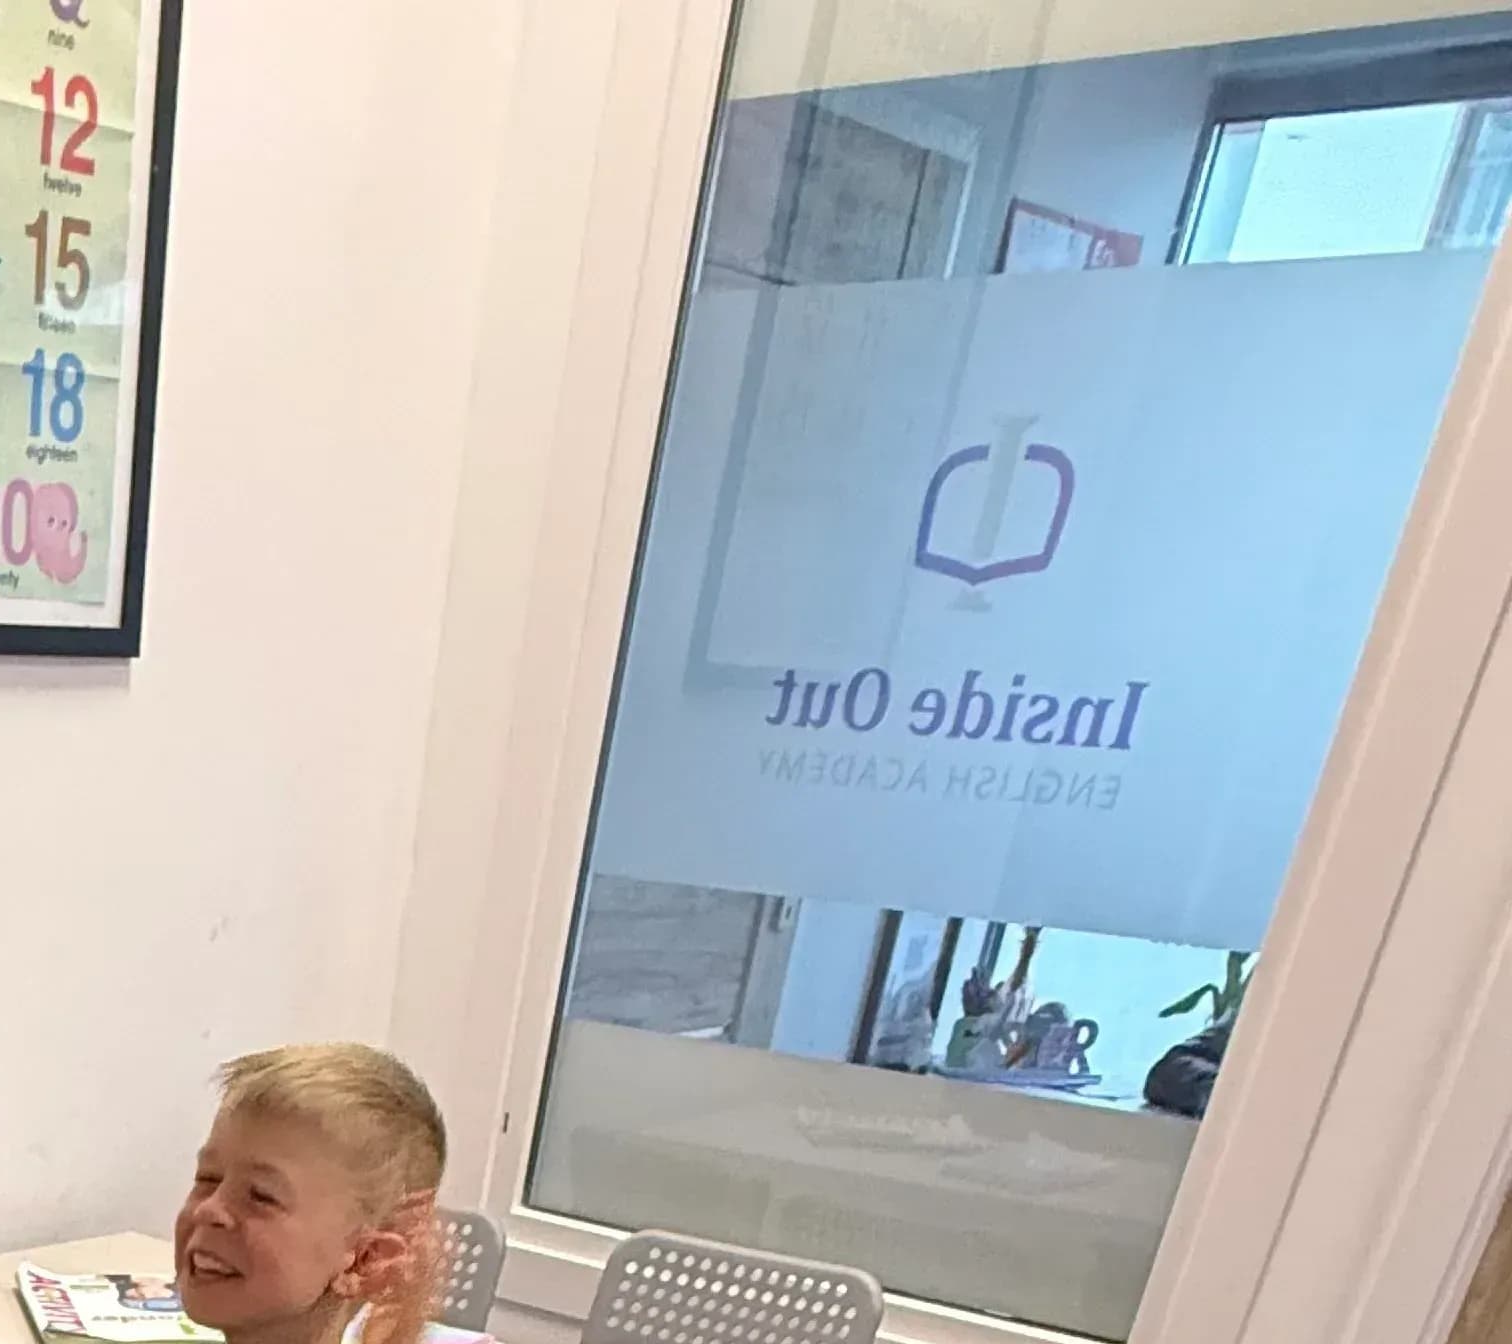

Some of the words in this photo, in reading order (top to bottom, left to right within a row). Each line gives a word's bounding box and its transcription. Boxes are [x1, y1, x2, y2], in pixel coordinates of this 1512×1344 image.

[31, 66, 98, 176] 12
[43, 172, 82, 197] twelve
[25, 208, 92, 312] 15
[22, 348, 86, 443] 18
[26, 443, 78, 464] eighteen
